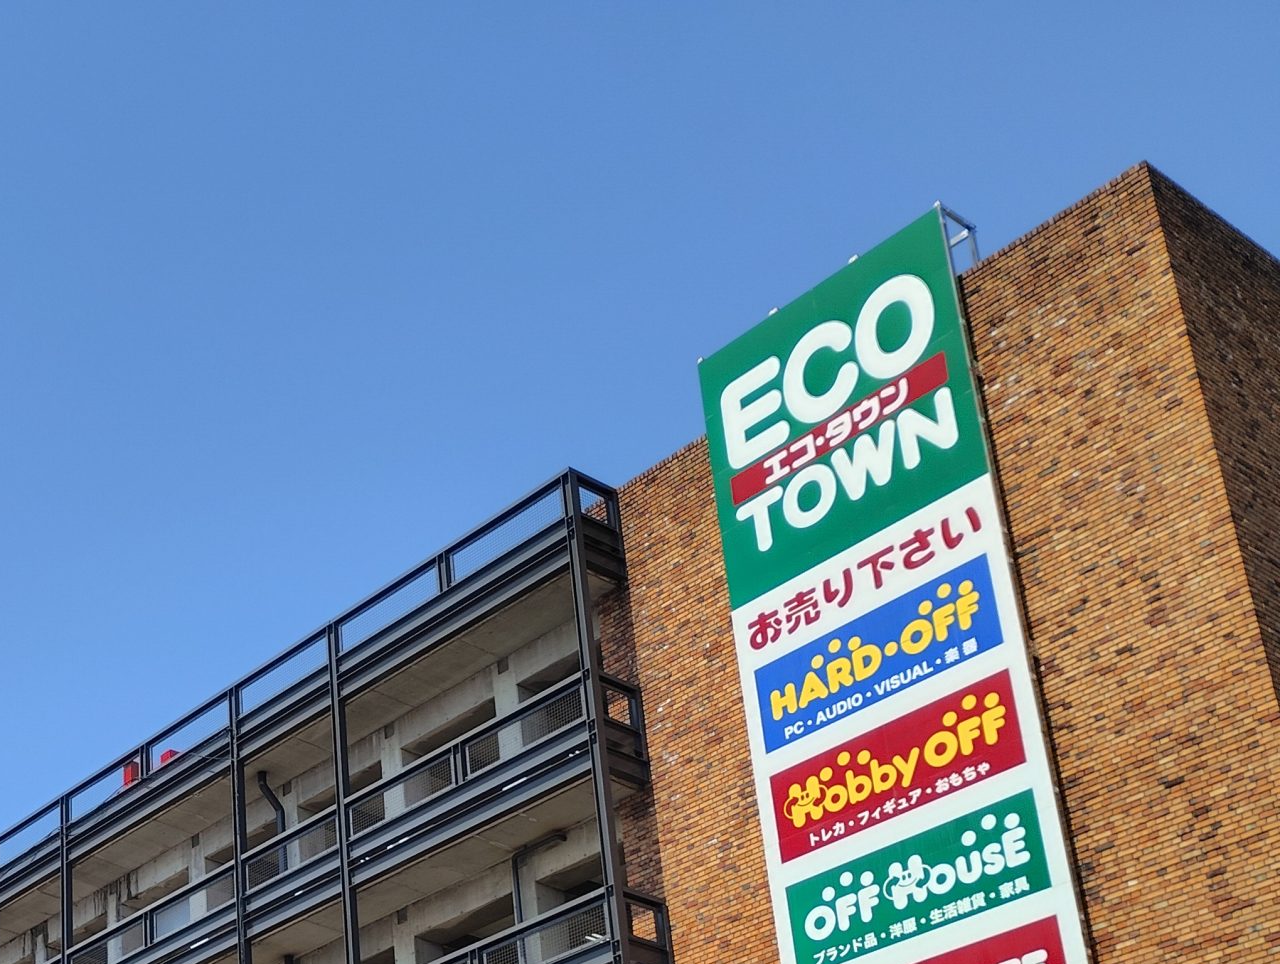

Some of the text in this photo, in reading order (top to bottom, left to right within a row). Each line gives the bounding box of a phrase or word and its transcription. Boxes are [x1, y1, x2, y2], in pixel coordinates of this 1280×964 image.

[721, 273, 935, 470] ECO
[763, 377, 909, 485] エコ・タウン
[735, 386, 959, 552] TOWN
[747, 506, 982, 650] お売り下さい
[785, 704, 1006, 828] Hobby OFF
[804, 884, 880, 941] OFF
